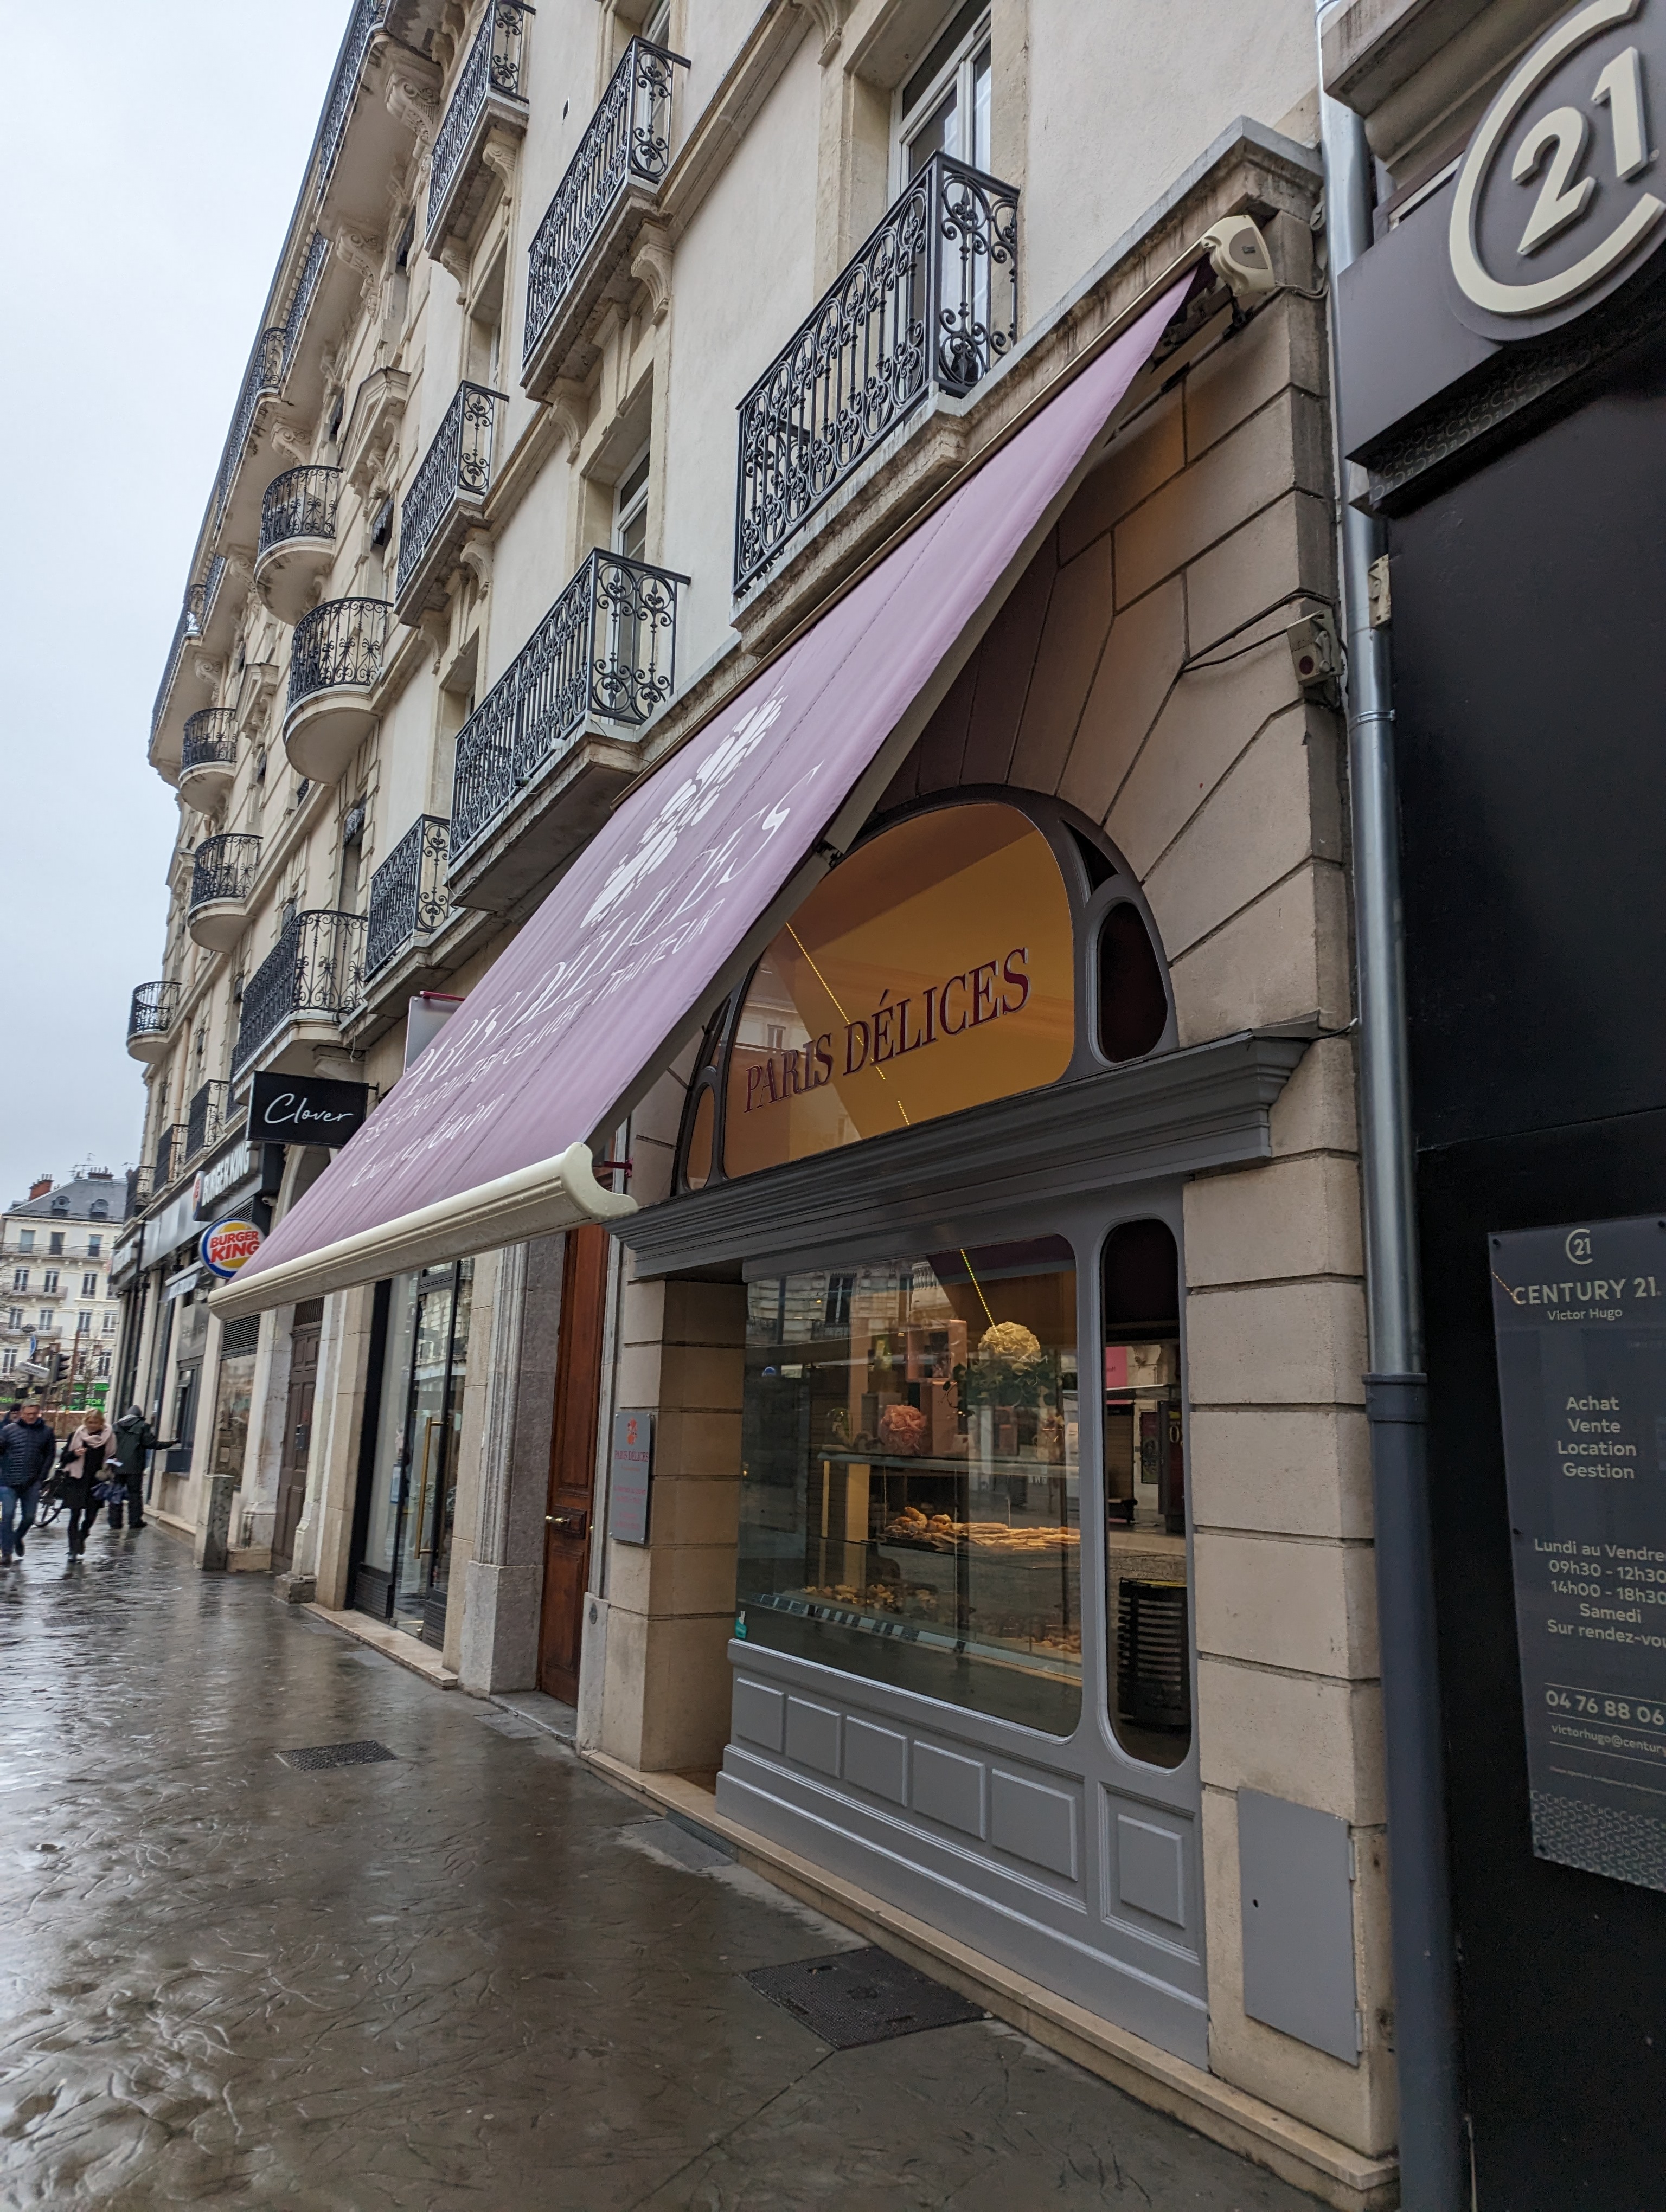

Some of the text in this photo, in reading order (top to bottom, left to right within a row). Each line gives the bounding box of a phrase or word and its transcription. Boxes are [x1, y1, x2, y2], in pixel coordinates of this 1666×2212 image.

[744, 947, 1031, 1114] PARIS DÉLICES
[264, 1093, 354, 1124] Clover
[210, 1231, 259, 1249] BURGER
[210, 1241, 260, 1263] KING
[1513, 1278, 1626, 1305] CENTURY
[1547, 1308, 1623, 1321] Victor Hugo
[1566, 1395, 1620, 1411] Achat
[1567, 1418, 1621, 1433] Vente
[1558, 1440, 1637, 1456] Location
[1563, 1462, 1635, 1480] Gestion
[1534, 1538, 1577, 1554] Lundi
[1582, 1545, 1600, 1556] au
[1549, 1559, 1601, 1577] 09h30
[1617, 1566, 1666, 1584] 12h30
[1551, 1580, 1600, 1597] 14h00
[1617, 1587, 1666, 1605] 18h30
[1580, 1603, 1642, 1623] Samedi
[1548, 1619, 1574, 1635] Sur
[1546, 1690, 1665, 1726] 04 76 88 06
